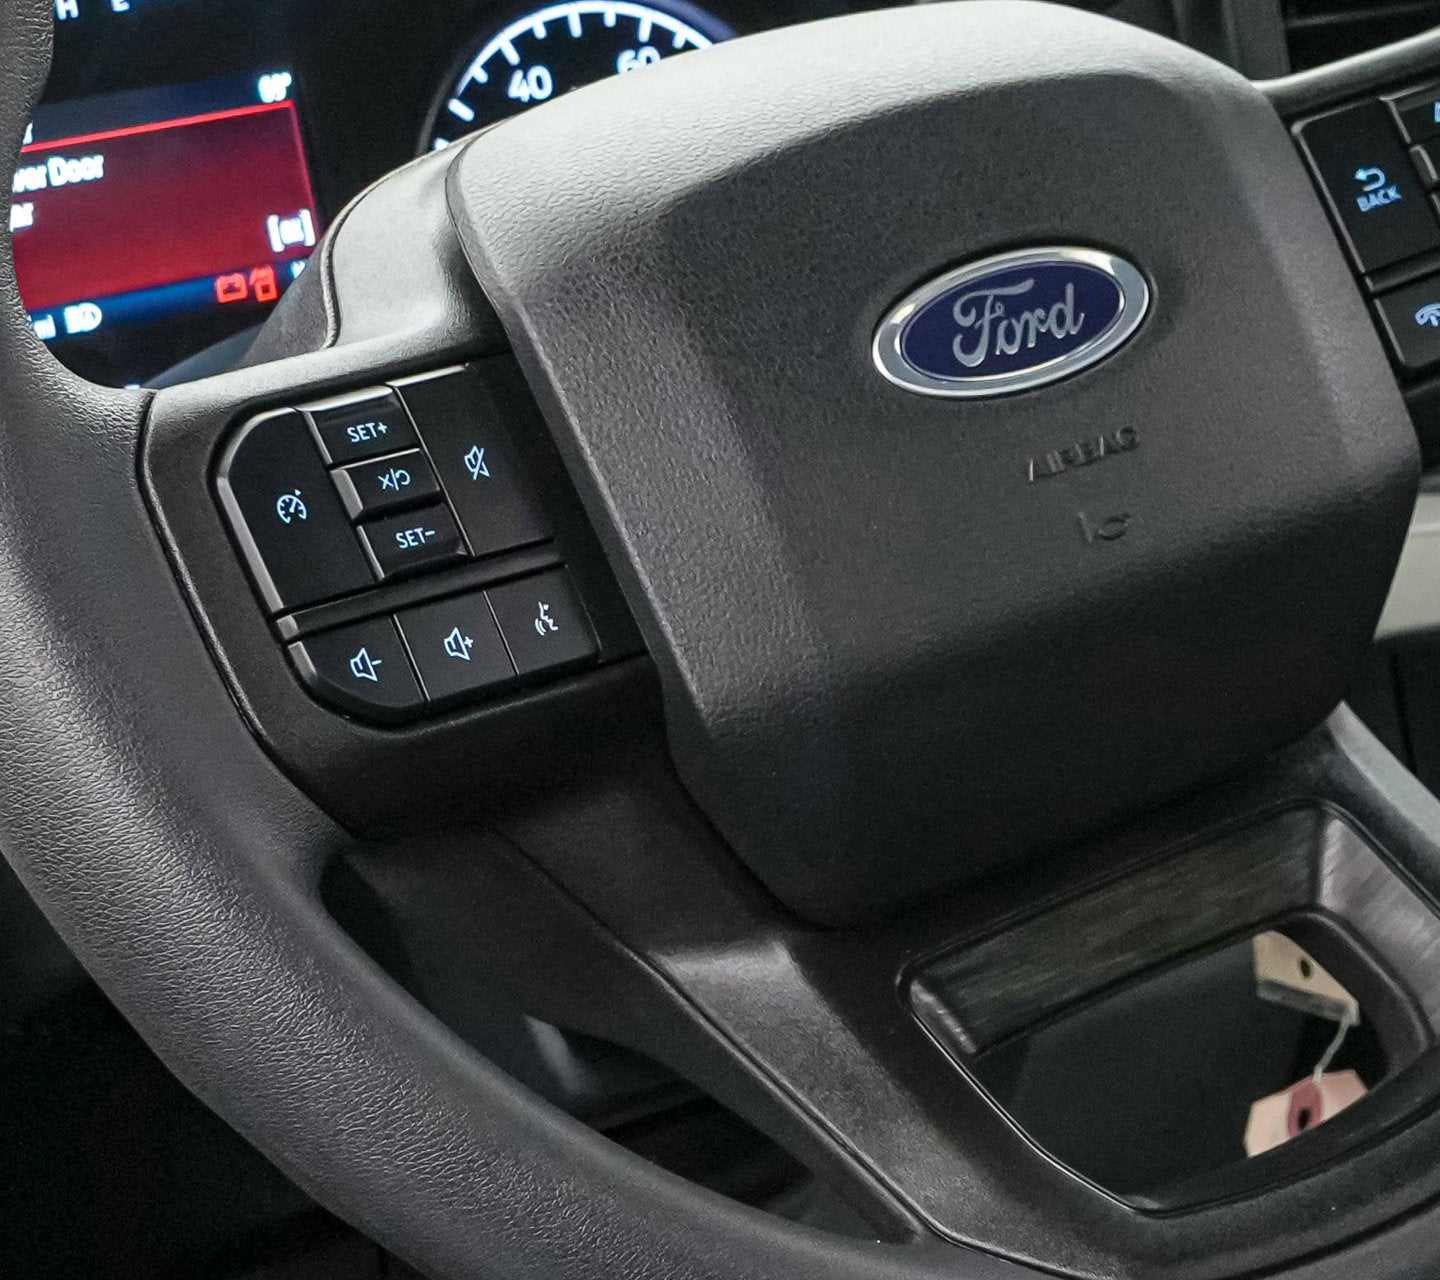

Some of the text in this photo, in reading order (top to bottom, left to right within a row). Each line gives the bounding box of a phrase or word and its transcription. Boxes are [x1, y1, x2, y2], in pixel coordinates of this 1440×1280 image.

[507, 65, 553, 102] 40
[47, 154, 105, 186] Door
[1356, 184, 1402, 212] BACK
[952, 277, 1086, 368] Ford
[346, 421, 389, 444] SET+
[394, 527, 437, 550] SET-
